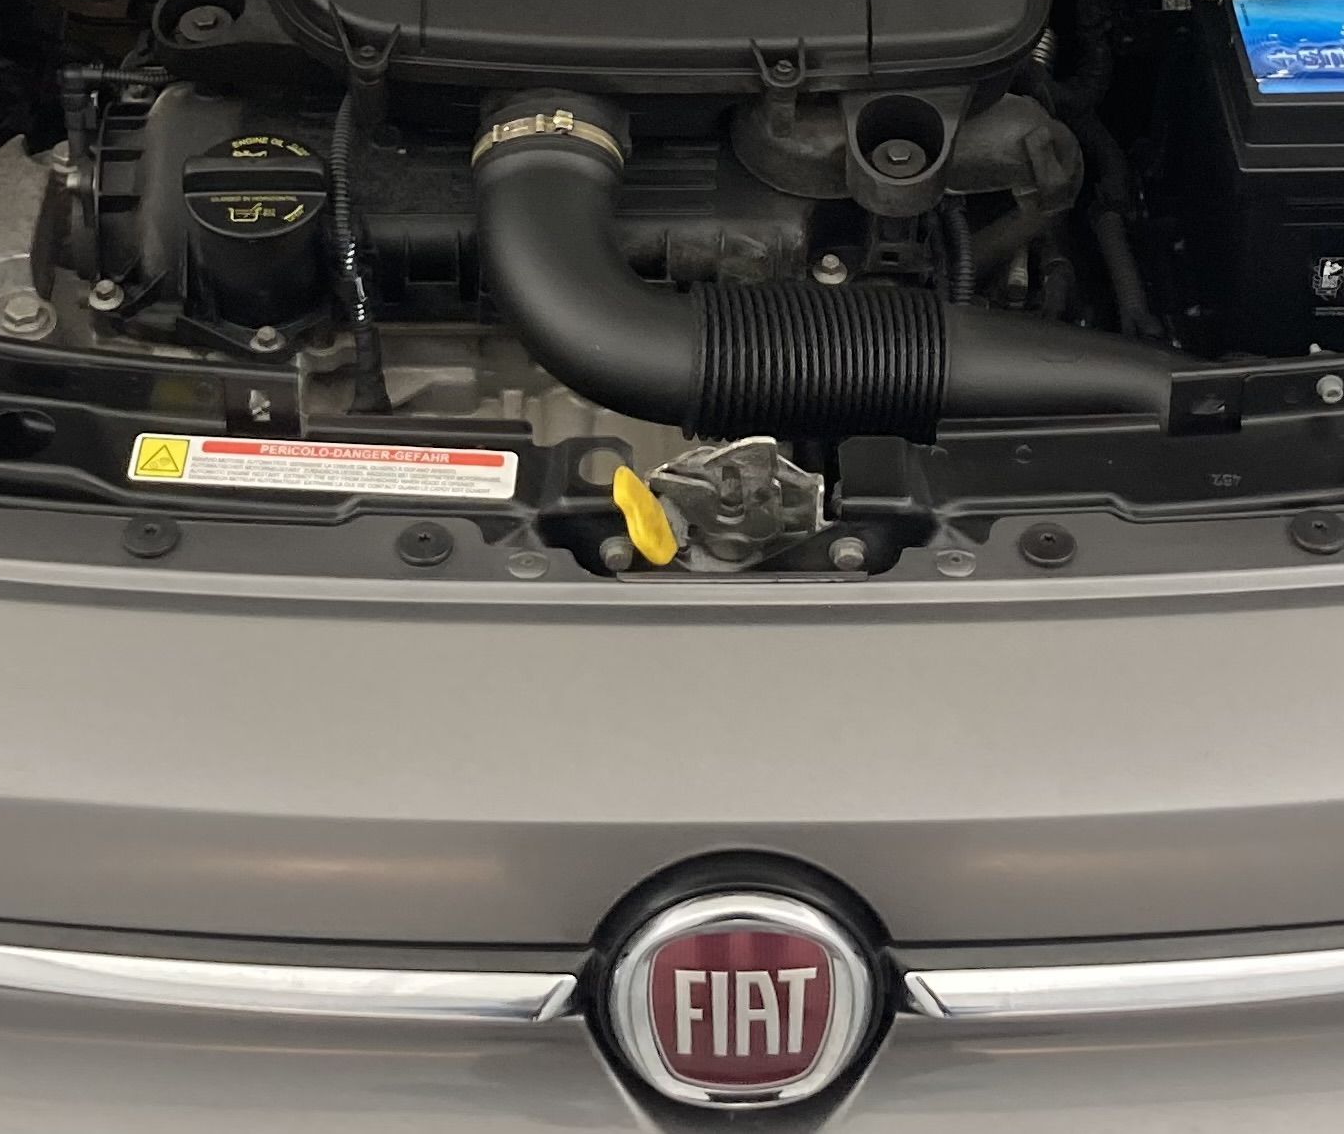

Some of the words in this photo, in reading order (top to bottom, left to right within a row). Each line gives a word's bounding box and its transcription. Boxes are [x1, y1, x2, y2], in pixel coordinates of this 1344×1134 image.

[231, 136, 269, 148] ENGINE
[259, 444, 451, 464] PERICOLO-DANGER-GEFAHR
[674, 966, 818, 1058] FIAT
